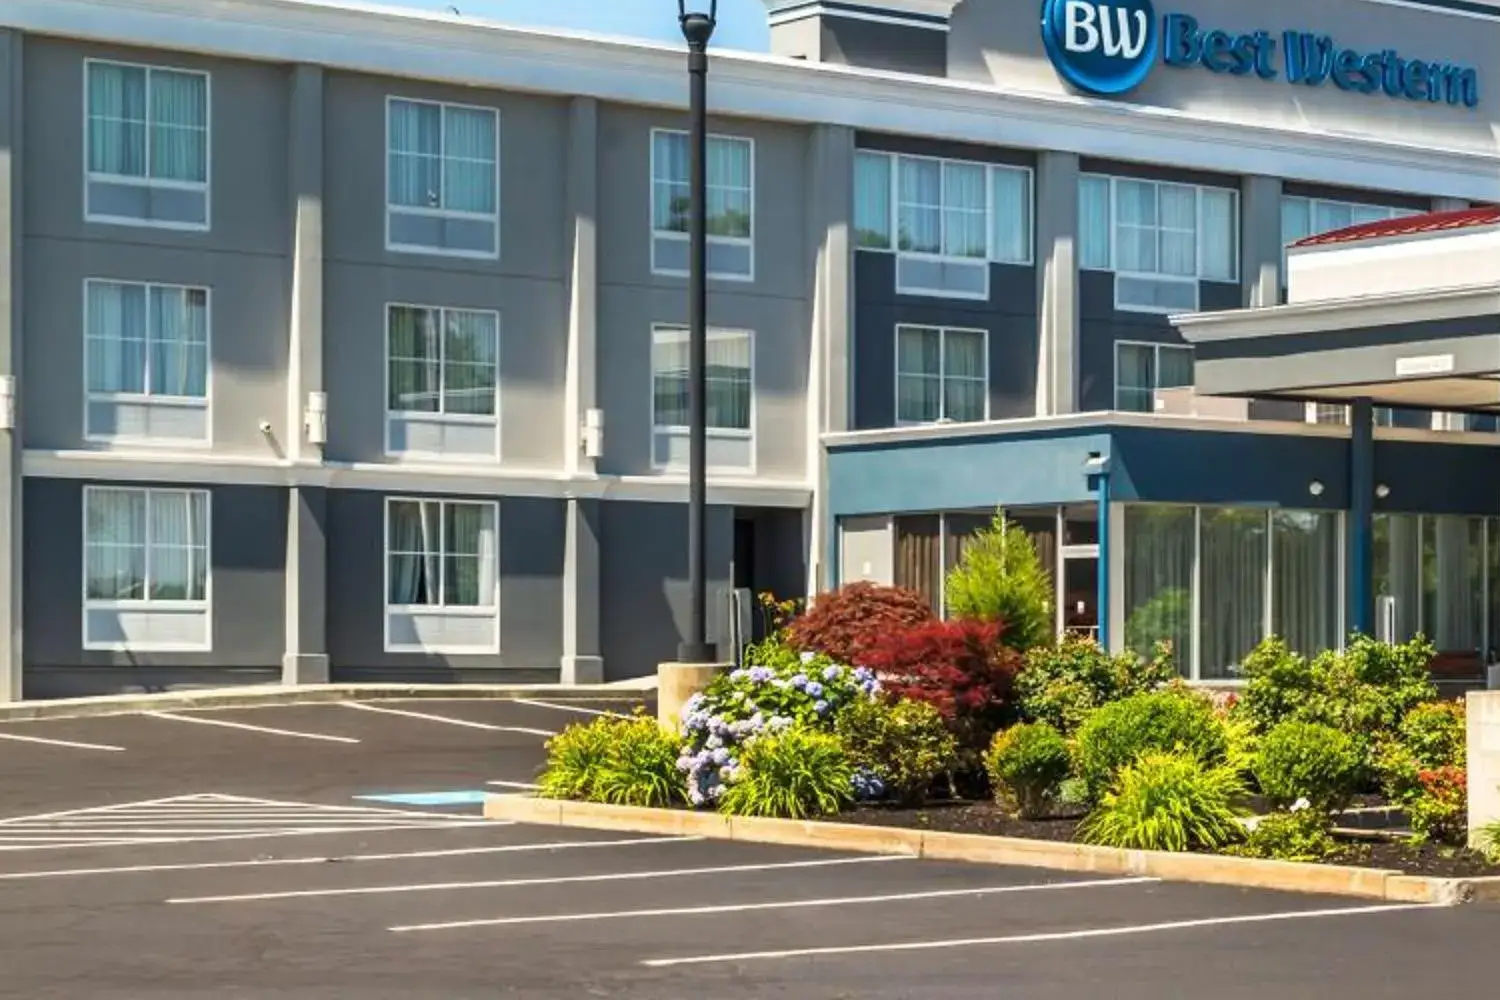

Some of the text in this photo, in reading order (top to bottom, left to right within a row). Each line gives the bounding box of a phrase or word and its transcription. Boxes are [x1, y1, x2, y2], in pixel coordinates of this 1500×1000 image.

[1064, 0, 1148, 59] BW
[1162, 12, 1479, 108] Best Western
